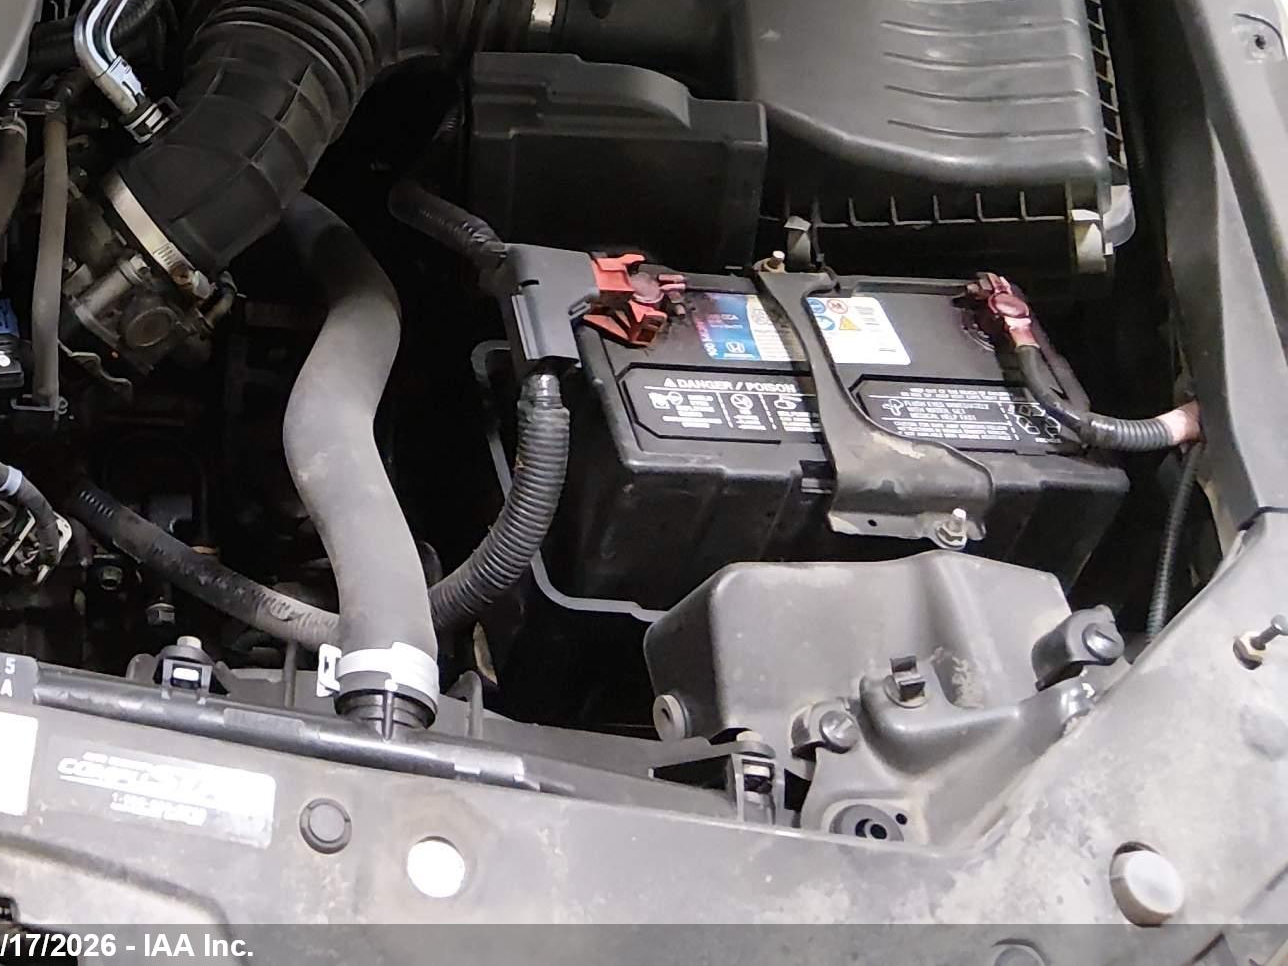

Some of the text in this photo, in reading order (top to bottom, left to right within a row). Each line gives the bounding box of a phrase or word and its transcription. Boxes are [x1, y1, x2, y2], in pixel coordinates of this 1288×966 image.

[677, 378, 733, 391] DANGER
[745, 381, 797, 394] POISON
[4, 656, 16, 675] 5
[0, 678, 13, 698] A
